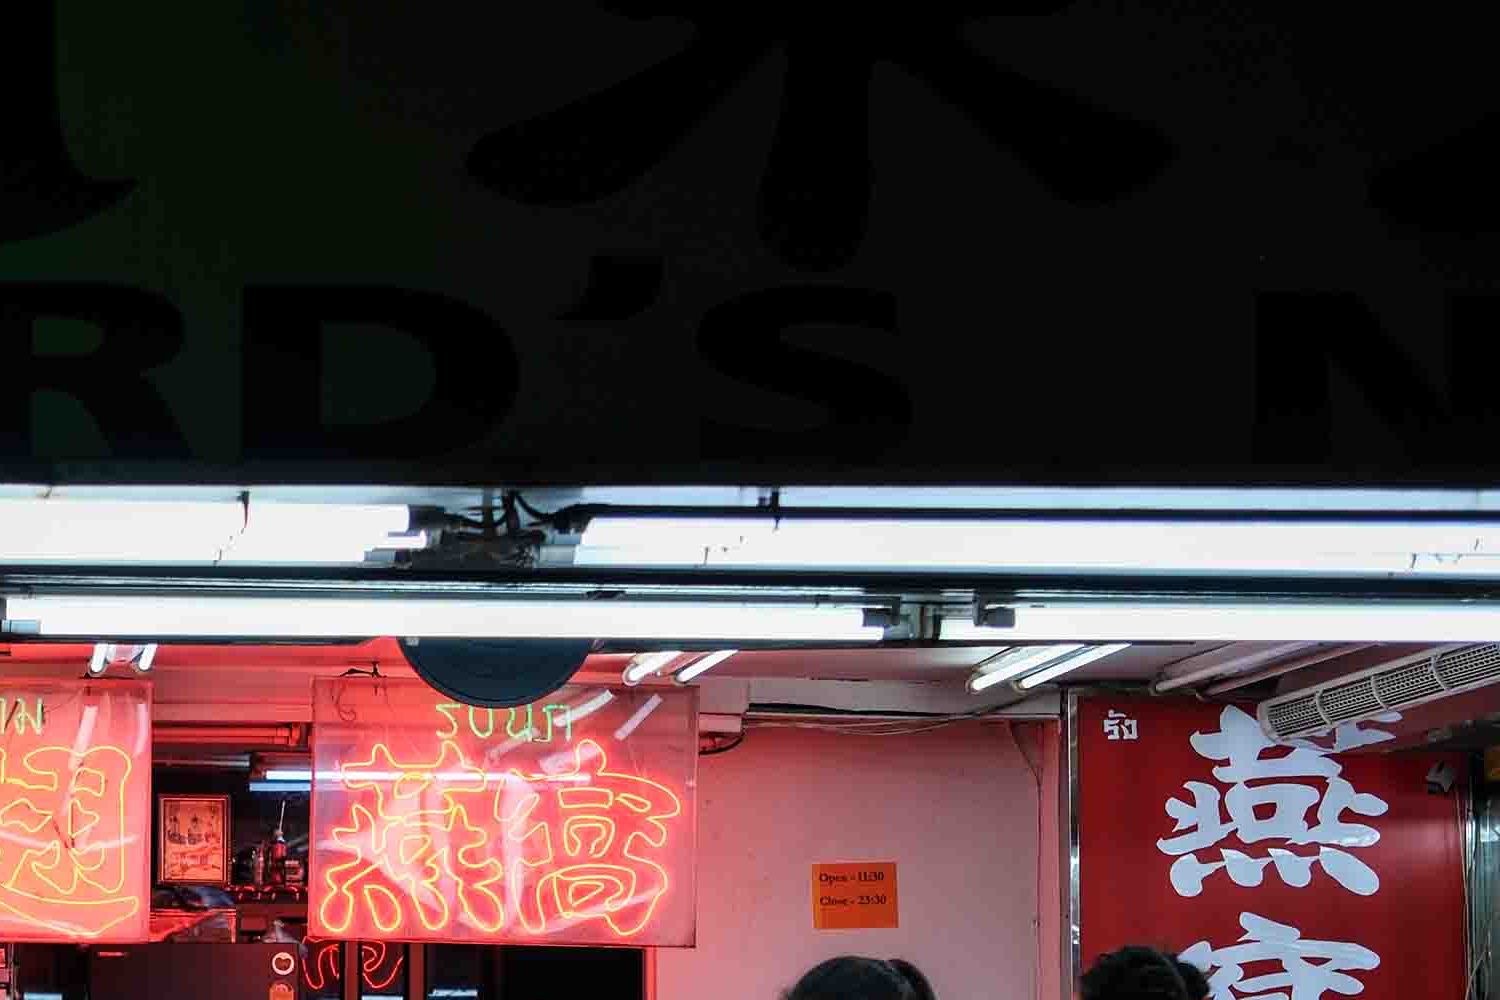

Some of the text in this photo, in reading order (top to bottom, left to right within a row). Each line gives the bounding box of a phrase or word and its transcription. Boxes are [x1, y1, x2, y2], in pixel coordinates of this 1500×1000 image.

[1103, 709, 1139, 740] รัง
[819, 873, 848, 886] Open
[819, 895, 848, 906] Close
